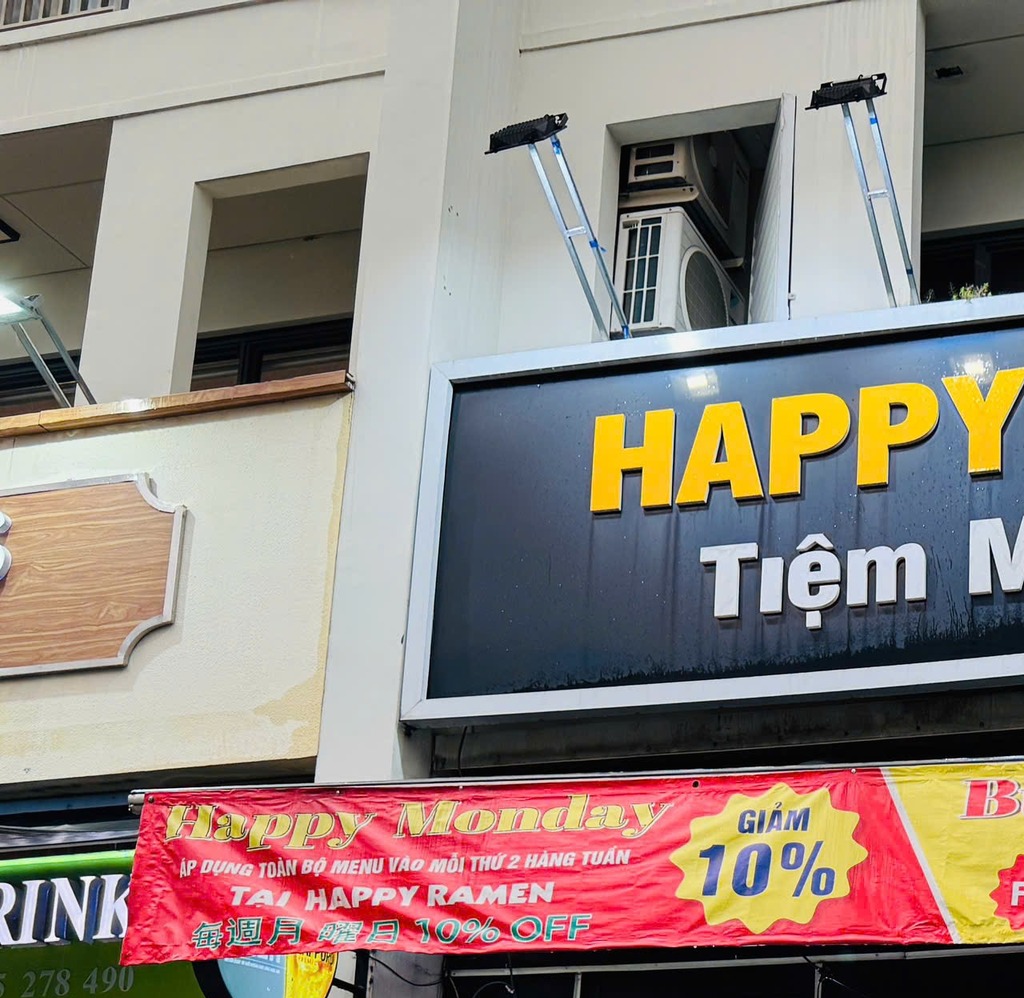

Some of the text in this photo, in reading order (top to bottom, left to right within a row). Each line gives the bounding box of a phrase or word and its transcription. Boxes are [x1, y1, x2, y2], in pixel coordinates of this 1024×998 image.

[700, 532, 927, 630] Tiệm
[164, 794, 674, 852] Happy Monday
[738, 801, 811, 834] GIẢM
[180, 850, 577, 878] ÁP DỤNG TOÀN BỘ MENU VÀO MỖI THỨ 2 HÀNG
[699, 840, 836, 898] 10%
[305, 885, 419, 911] HAPPY
[427, 882, 555, 907] RAMEN
[415, 917, 500, 944] 10%
[510, 914, 592, 942] OFF
[21, 968, 71, 998] 278
[82, 966, 135, 994] 490
